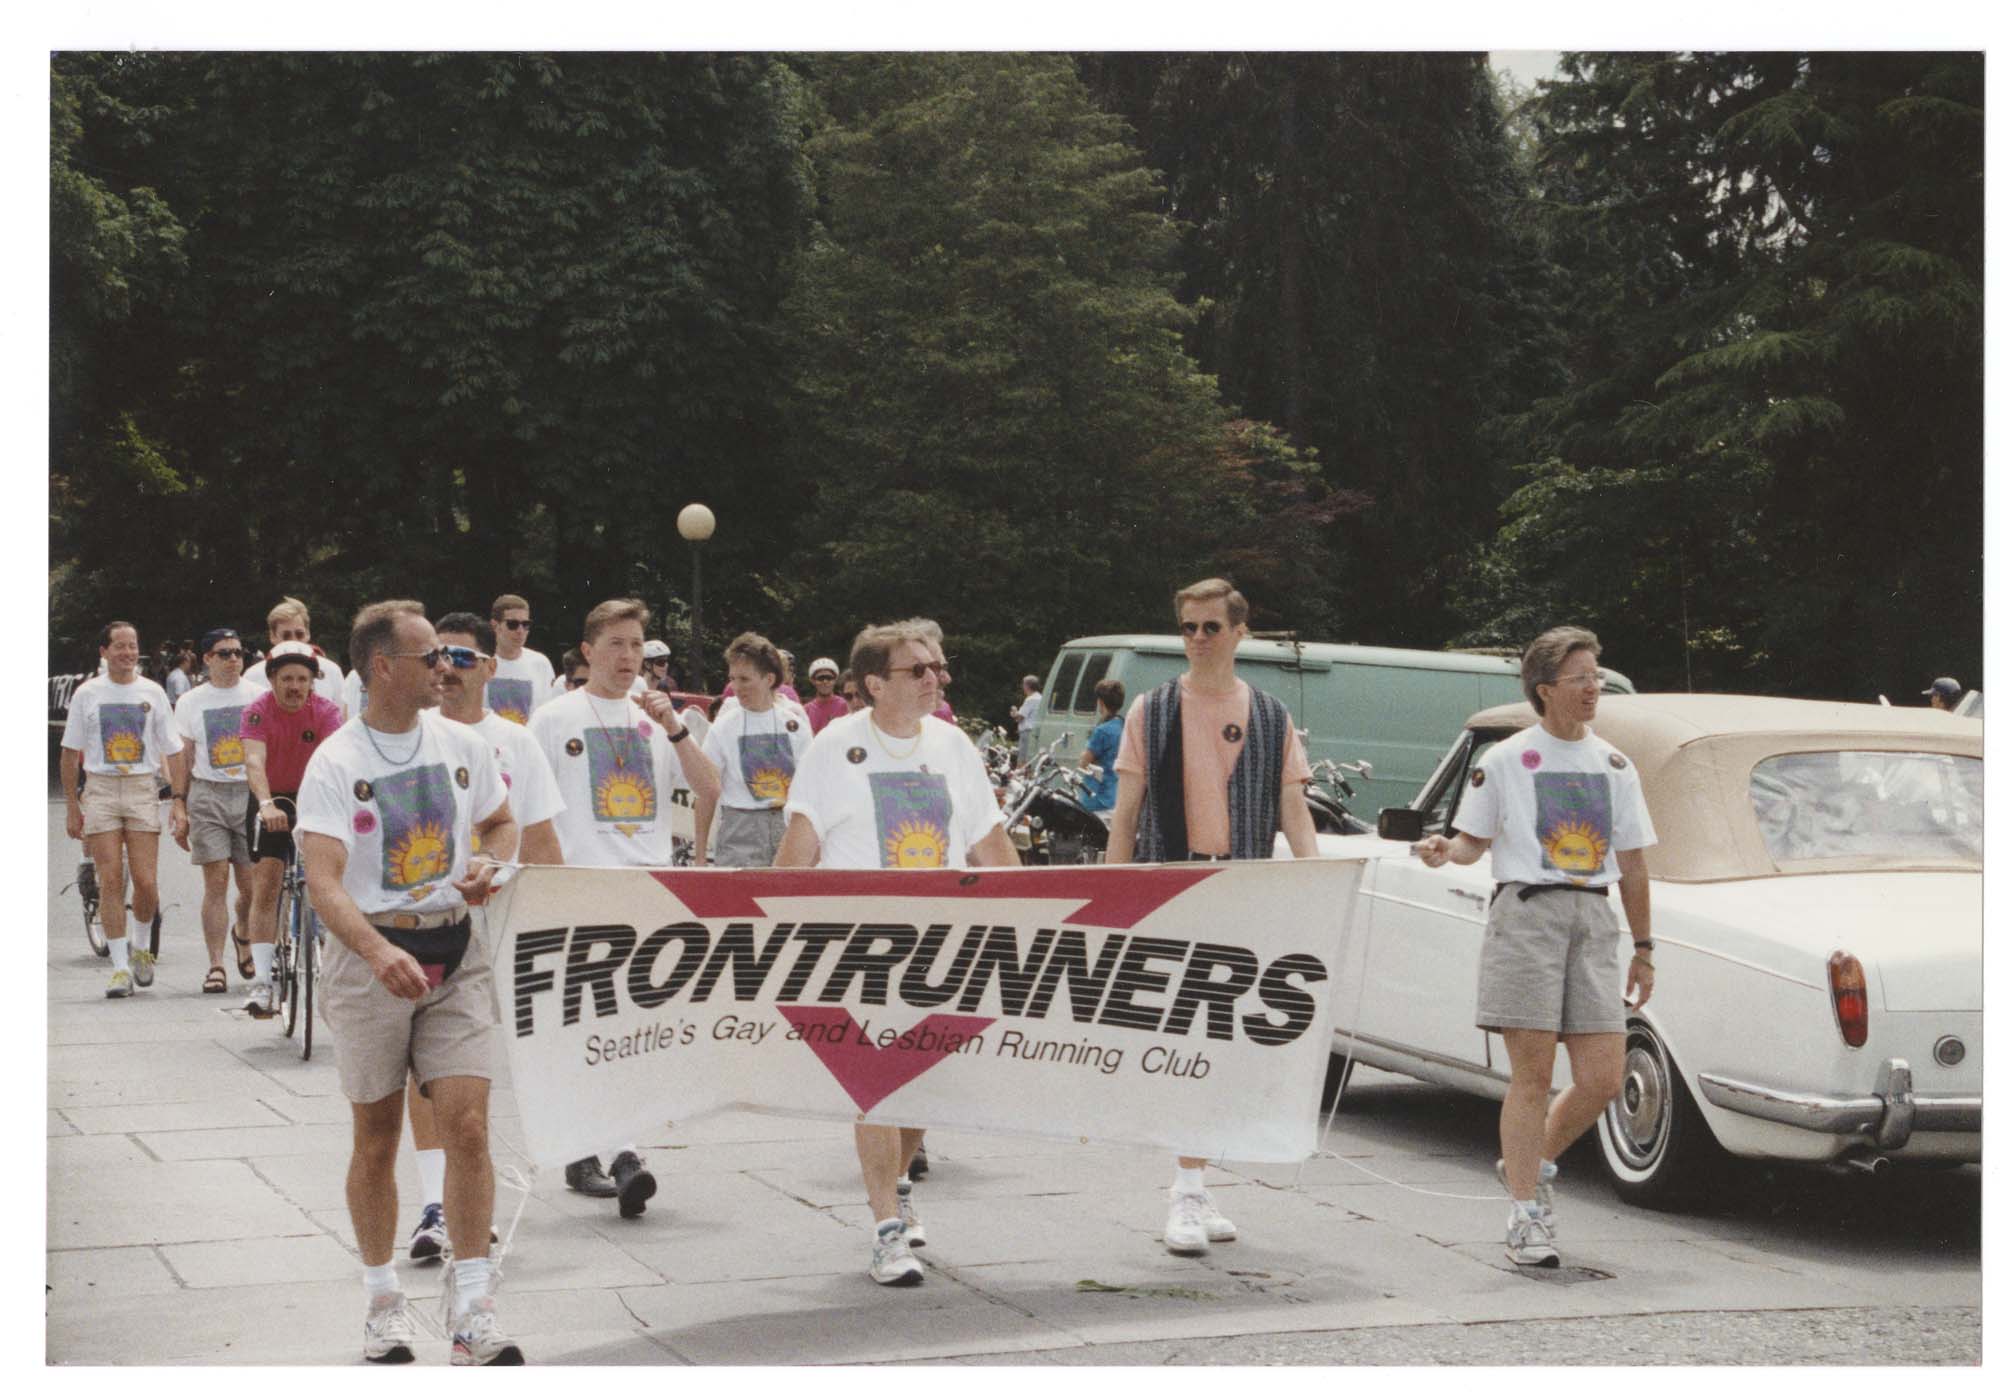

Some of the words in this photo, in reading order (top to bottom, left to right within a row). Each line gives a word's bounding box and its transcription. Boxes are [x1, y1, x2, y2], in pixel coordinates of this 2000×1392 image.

[514, 922, 1328, 1046] FRONTRUNNERS
[585, 1019, 697, 1066] Seattle's
[711, 1014, 776, 1045] Gay
[786, 1018, 848, 1045] and
[857, 1019, 984, 1056] Lesbian
[997, 1030, 1123, 1075] Running
[1141, 1046, 1211, 1080] Club
